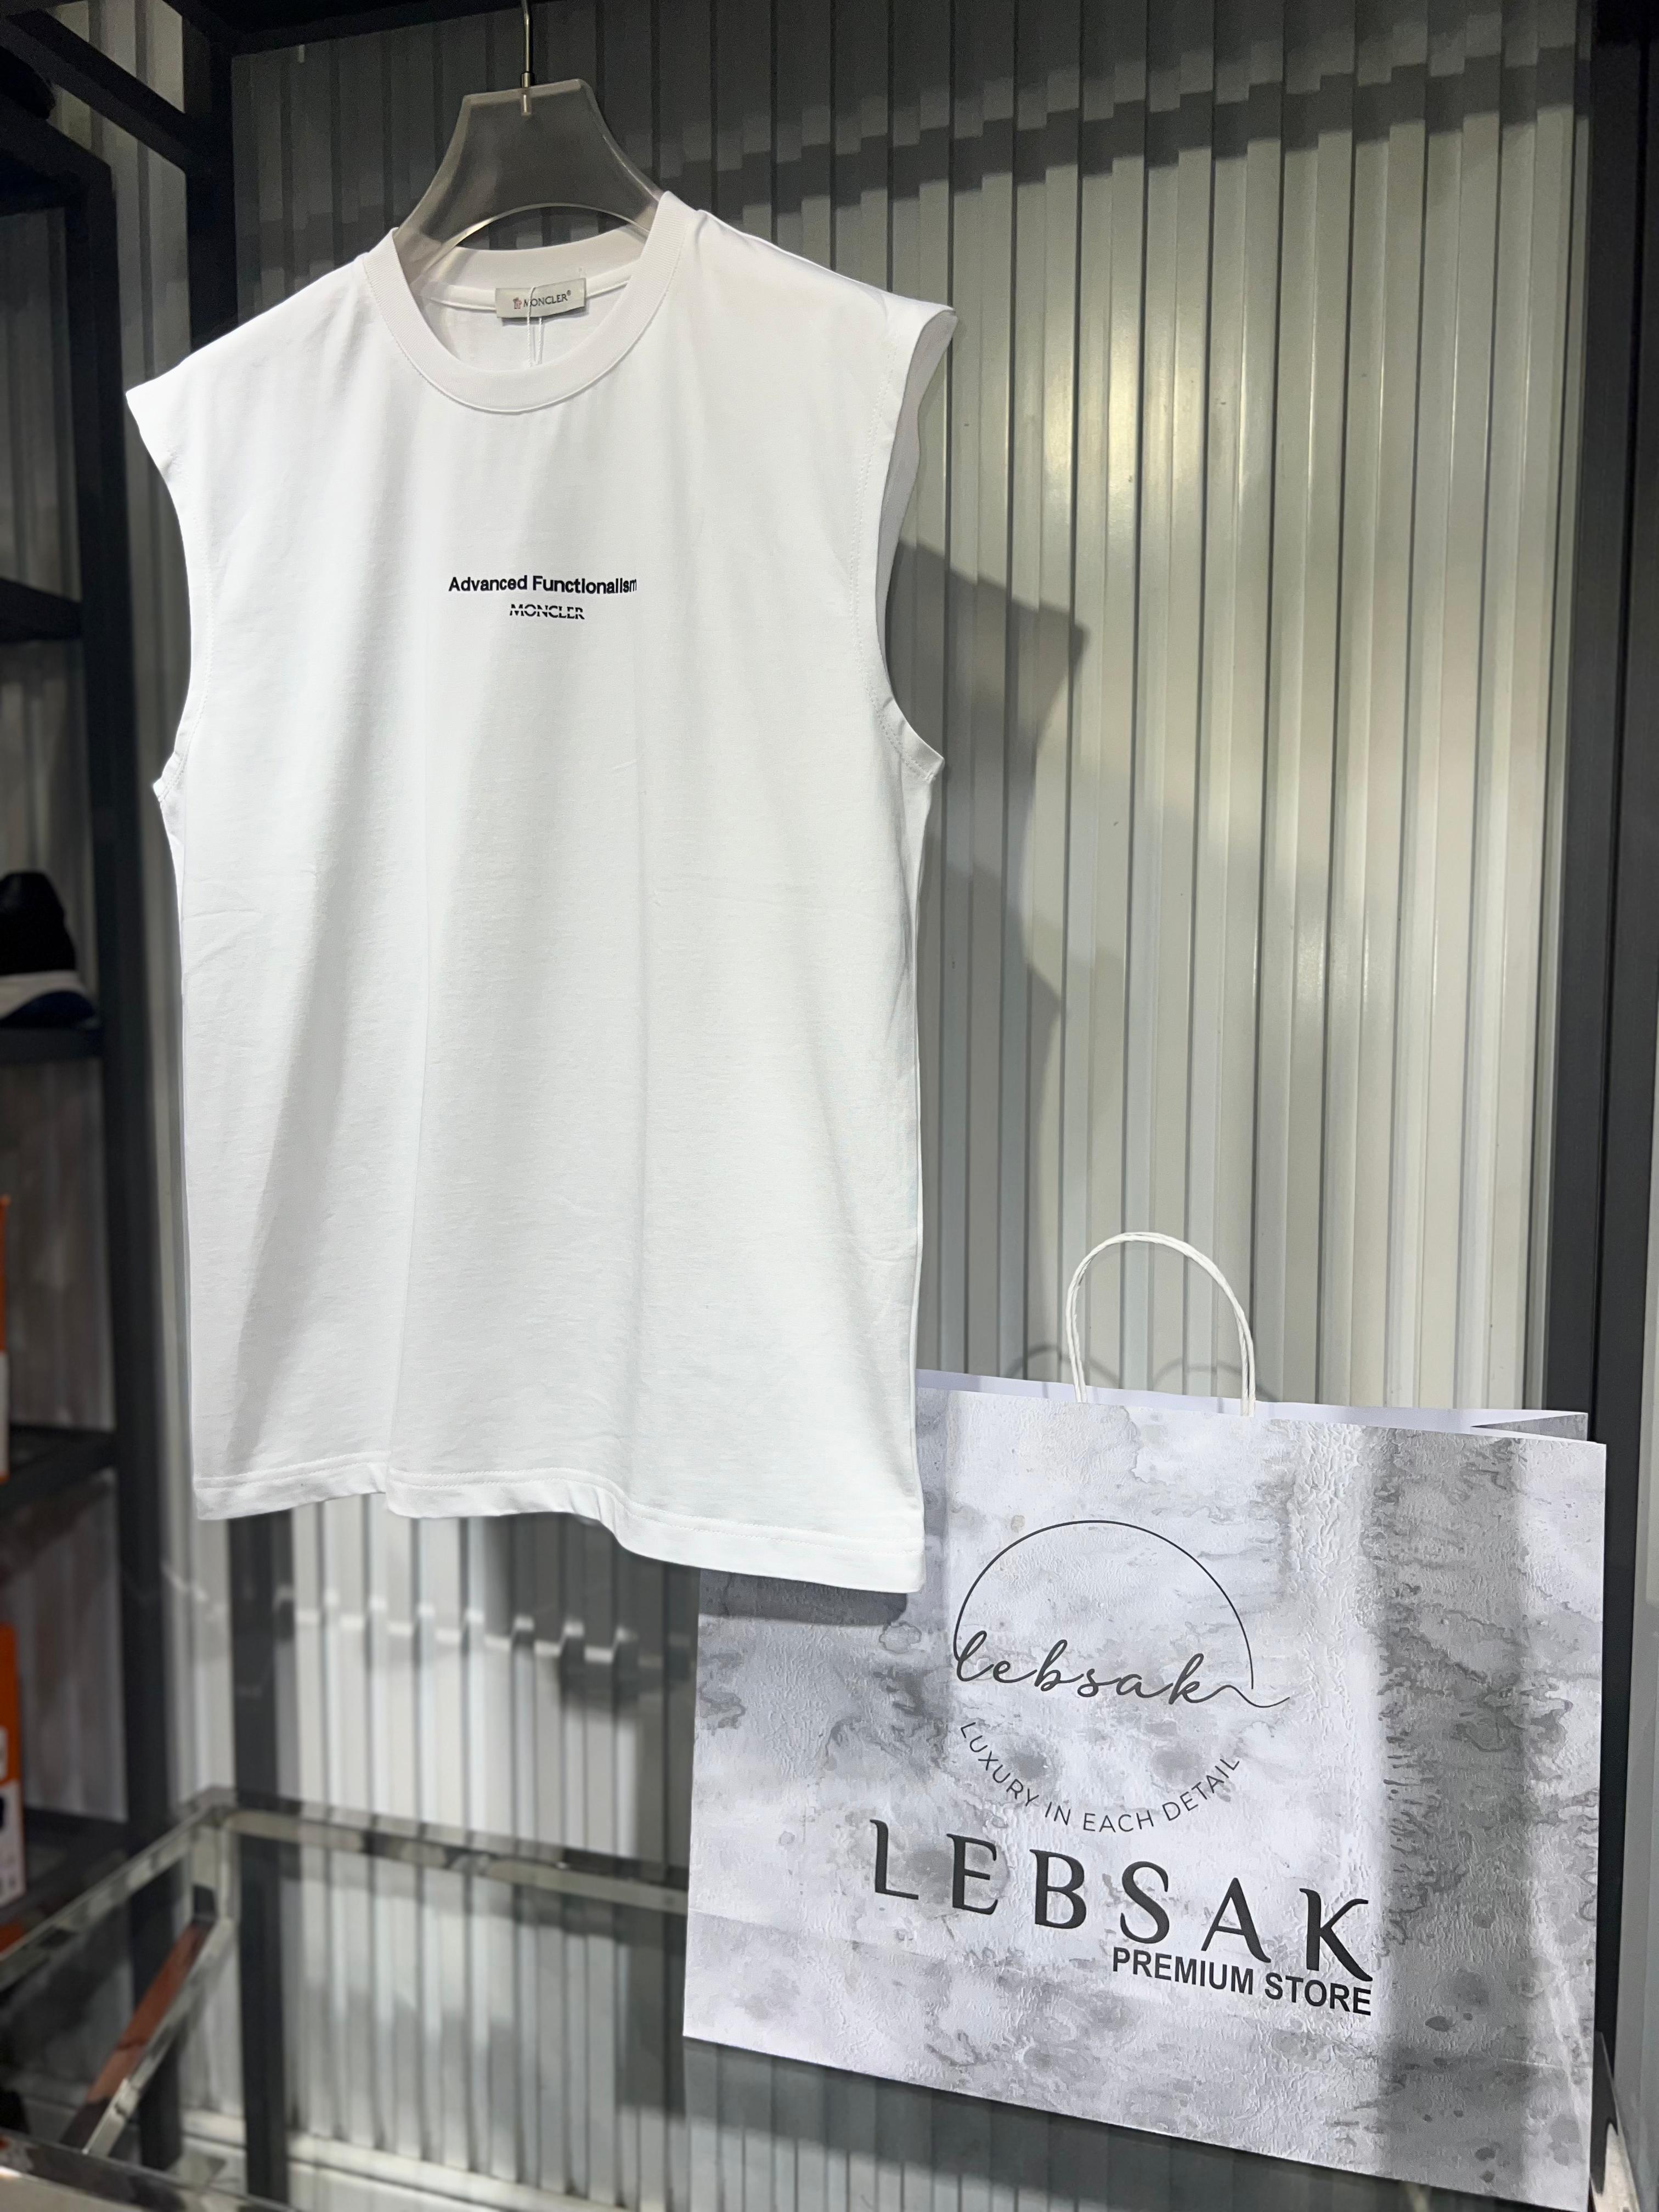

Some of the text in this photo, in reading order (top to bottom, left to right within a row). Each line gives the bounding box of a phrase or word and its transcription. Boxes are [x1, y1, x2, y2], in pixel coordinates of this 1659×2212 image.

[448, 574, 637, 594] Advanced Functionalism
[509, 603, 585, 620] MONCLER
[953, 1630, 1290, 1708] lebsak
[960, 1722, 1240, 1833] LUXURY IN EACH DETAIL
[869, 1819, 1373, 1982] LEBSAK
[1112, 1946, 1372, 2017] PREMIUM STORE
